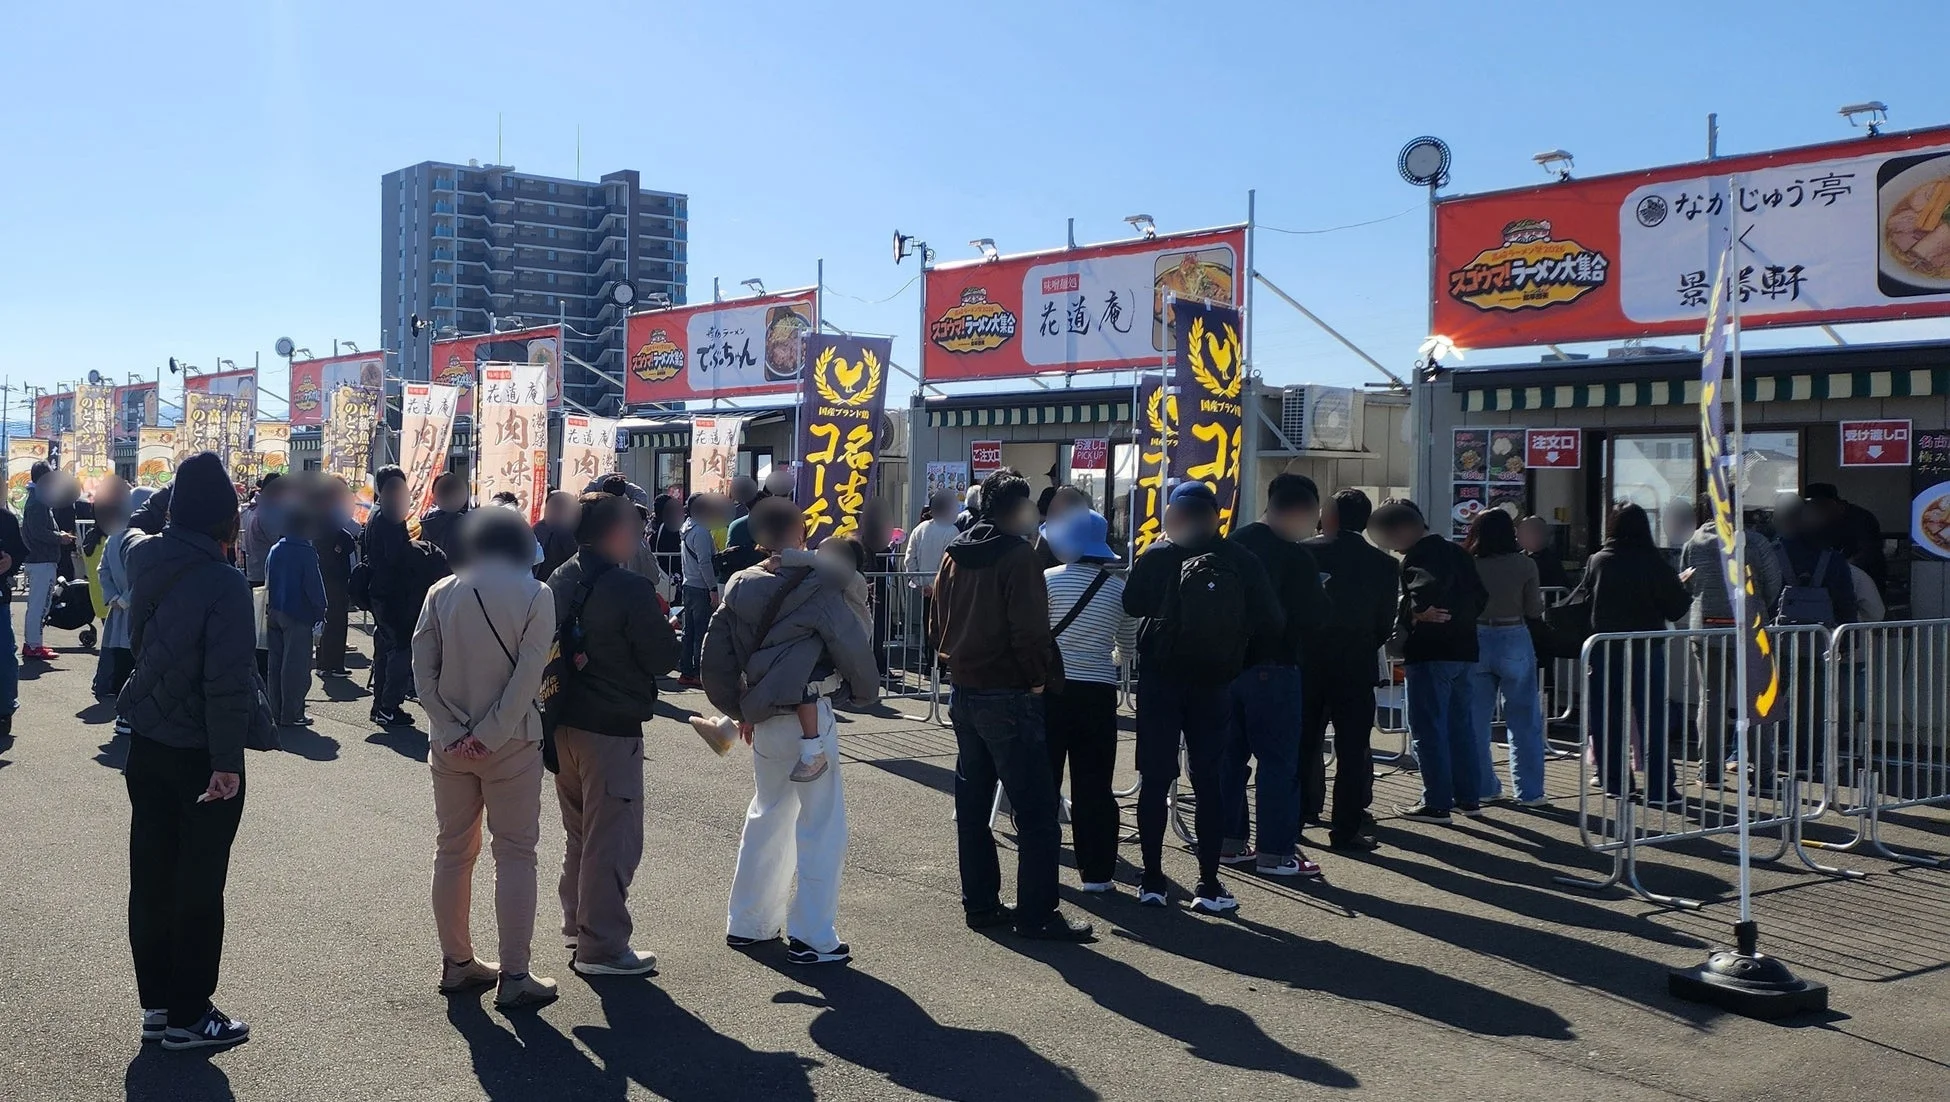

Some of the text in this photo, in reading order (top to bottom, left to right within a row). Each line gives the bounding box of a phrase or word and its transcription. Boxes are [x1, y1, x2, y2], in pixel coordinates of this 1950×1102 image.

[1675, 172, 1855, 220] なかじゅう亭
[1040, 288, 1136, 337] 花道庵
[486, 381, 545, 406] 花道庵
[818, 406, 870, 419] 国産ブランド鶏
[1532, 434, 1575, 450] 注文口
[1845, 428, 1908, 442] 受け渡し口
[1918, 434, 1950, 449] 名古
[1074, 439, 1107, 451] お渡し口
[1076, 451, 1104, 461] PICK UP
